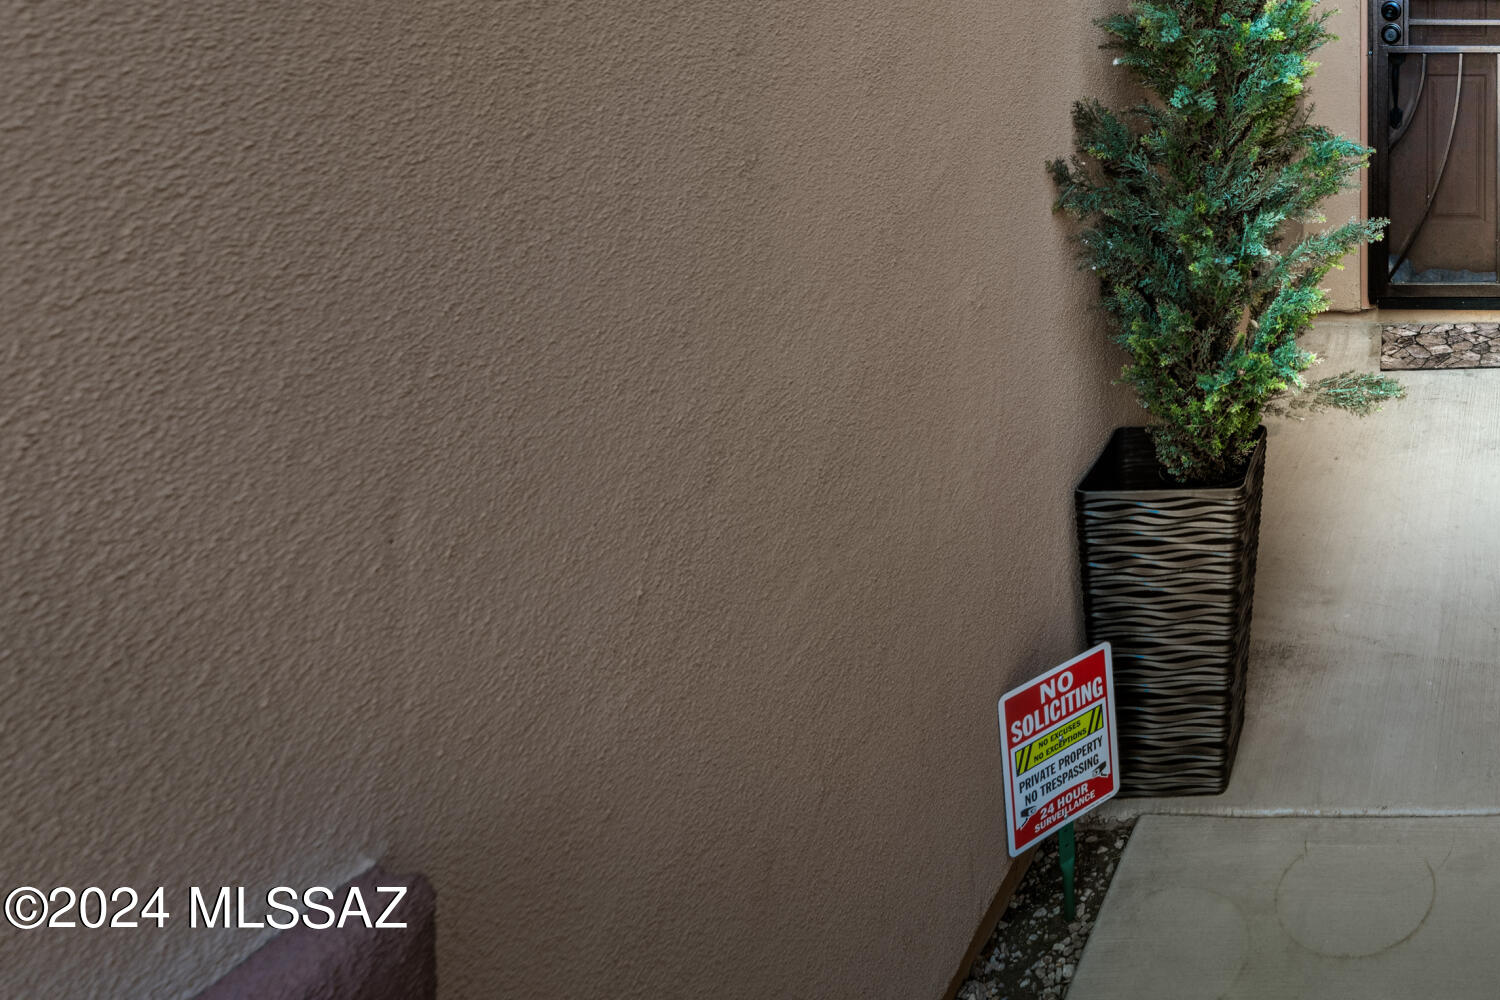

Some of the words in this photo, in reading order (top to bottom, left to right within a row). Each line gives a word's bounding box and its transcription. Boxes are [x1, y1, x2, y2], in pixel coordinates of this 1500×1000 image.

[1039, 670, 1074, 705] NO
[1010, 675, 1104, 744] SOLICITING
[1033, 751, 1044, 763] NO
[1045, 728, 1087, 757] EXCEPTIONS
[1038, 737, 1048, 749] NO
[1050, 720, 1081, 743] EXCUSES
[1018, 764, 1056, 794] PRIVATE
[1058, 735, 1104, 770] PROPERTY
[1024, 789, 1038, 806] NO
[1041, 753, 1099, 797] TRESPASSING
[1034, 789, 1096, 834] SURVEILLANCE
[1040, 800, 1056, 820] 24
[1057, 783, 1089, 811] HOUR
